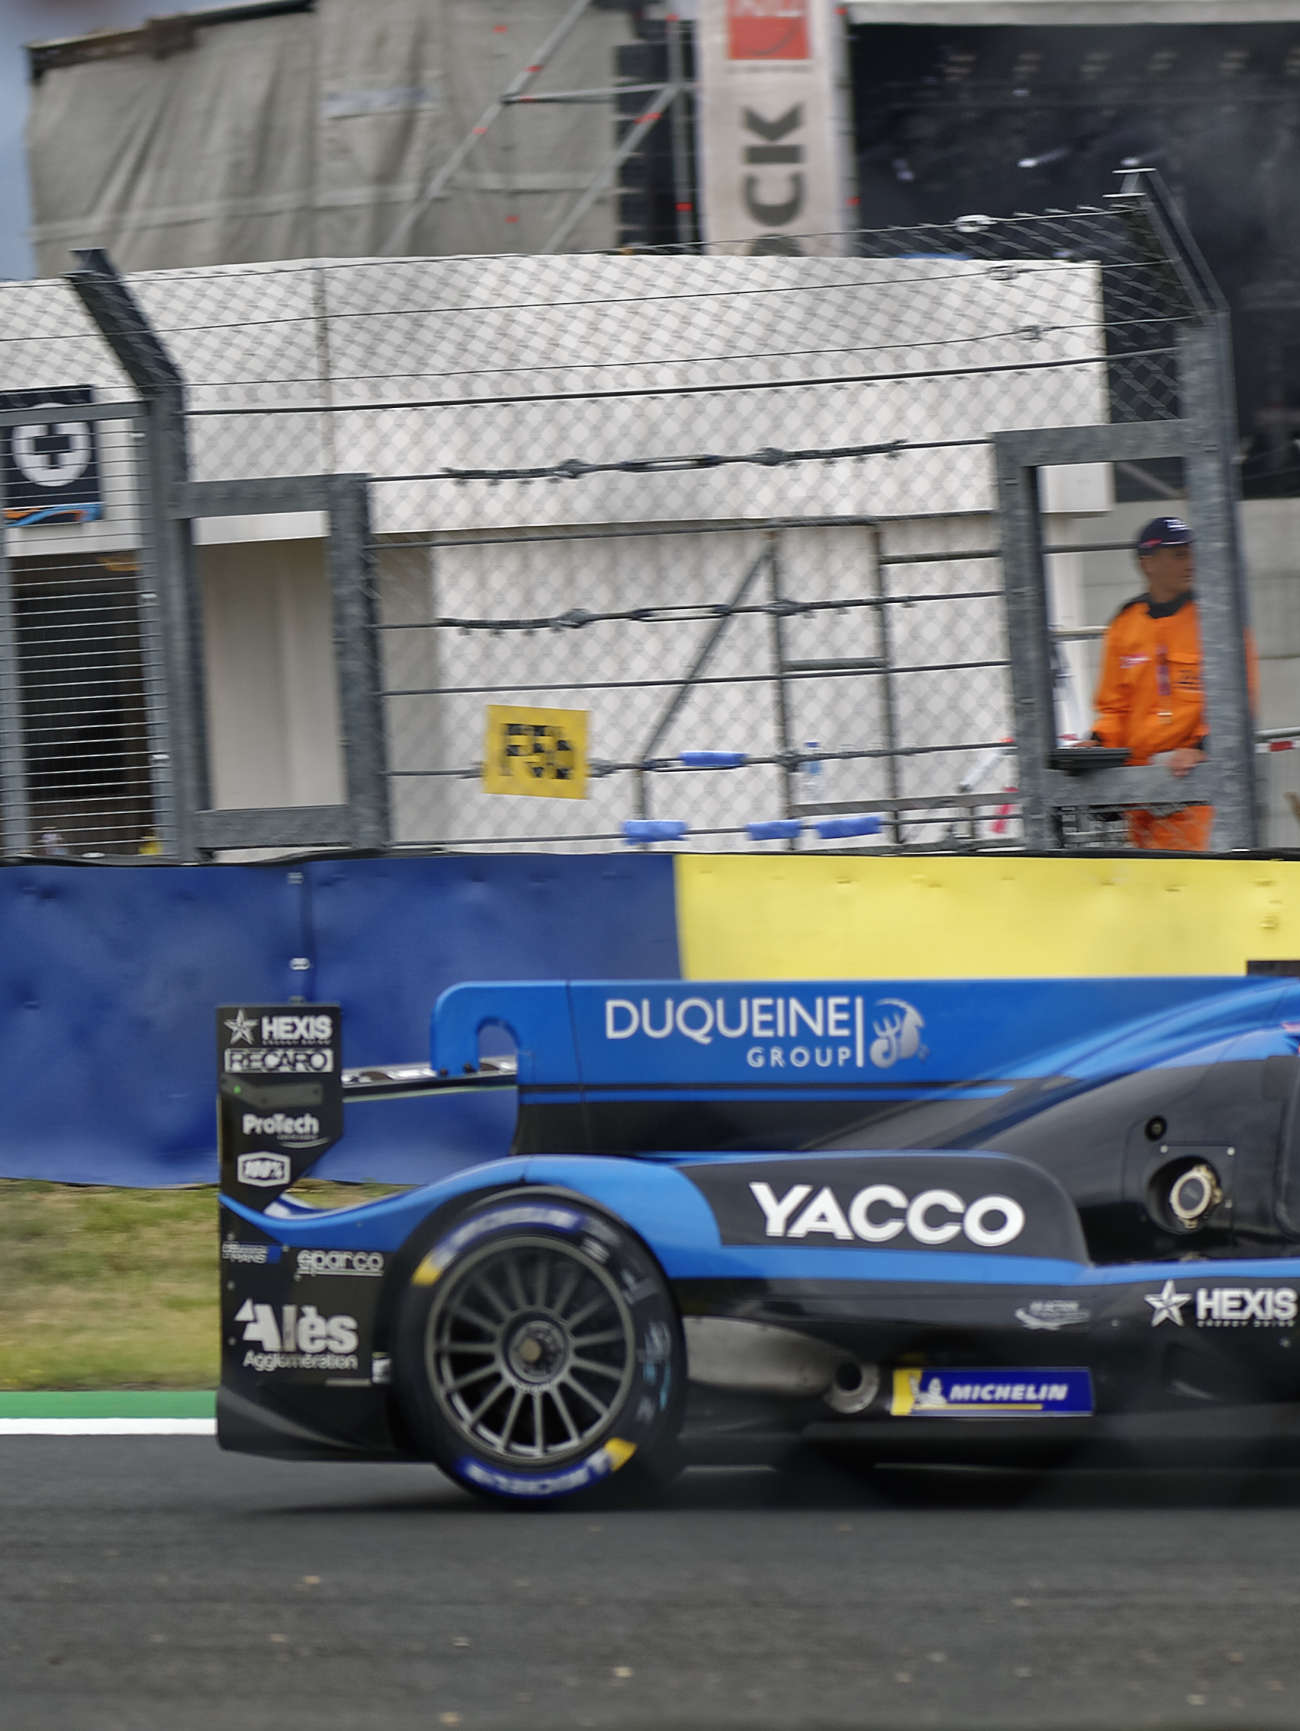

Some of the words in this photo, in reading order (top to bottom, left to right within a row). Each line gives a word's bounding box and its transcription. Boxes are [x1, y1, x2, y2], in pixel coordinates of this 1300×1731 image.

[261, 1014, 333, 1041] HEXIS
[605, 996, 851, 1044] DUQUEINE
[229, 1049, 329, 1073] RECARO
[746, 1046, 851, 1068] GROUP
[242, 1112, 320, 1136] ProTech
[749, 1181, 1026, 1248] YACCO
[296, 1249, 385, 1277] sparco
[1195, 1287, 1299, 1321] HEXIS
[233, 1298, 359, 1355] Alès
[949, 1383, 1069, 1402] MICHELIN
